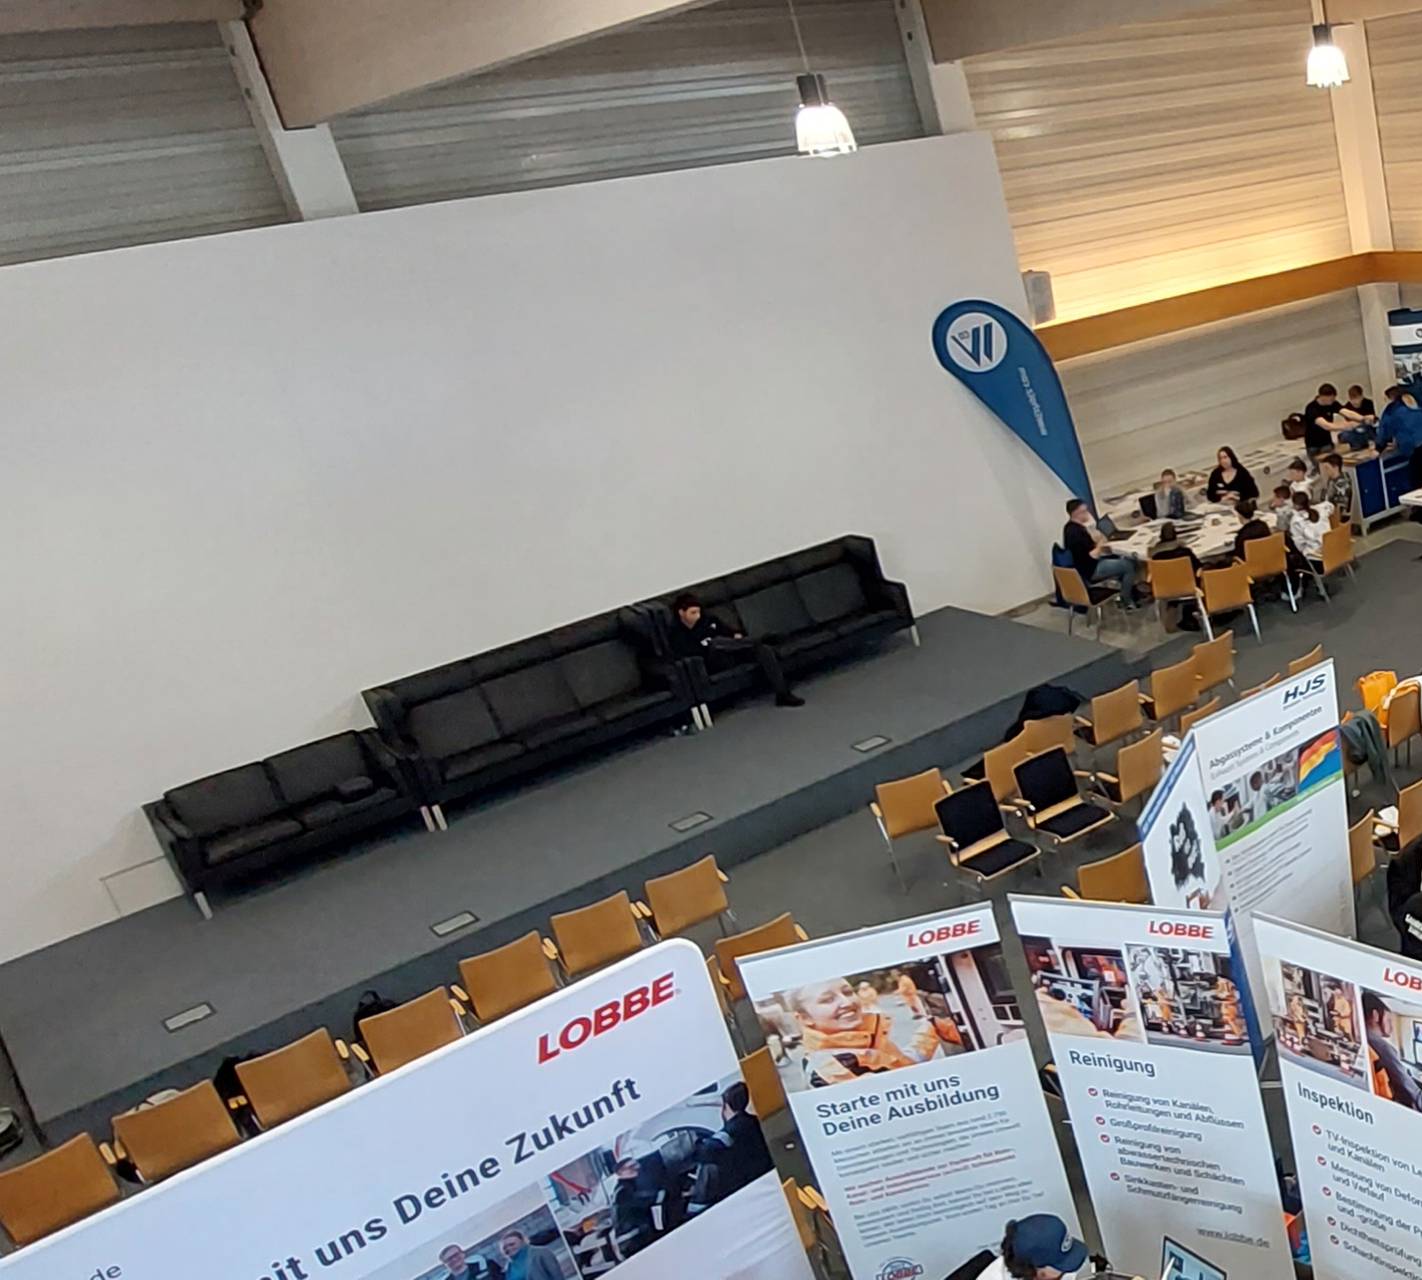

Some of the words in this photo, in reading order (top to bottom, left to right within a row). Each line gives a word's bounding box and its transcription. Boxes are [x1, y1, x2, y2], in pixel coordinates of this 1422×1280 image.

[1283, 673, 1326, 704] HJS
[1209, 736, 1264, 769] Abgassysteme
[1272, 706, 1323, 736] Komponenten
[907, 919, 983, 948] LOBBE
[1148, 920, 1214, 940] LOBBE
[538, 971, 674, 1064] LOBBE
[1069, 1050, 1156, 1078] Reinigung
[816, 1094, 881, 1119] Starte
[885, 1081, 920, 1103] mit
[923, 1073, 961, 1095] uns
[1103, 1089, 1150, 1106] Reinigung
[1105, 1100, 1172, 1119] Rohrleitungen
[1174, 1110, 1192, 1121] und
[1297, 1082, 1374, 1125] Inspektion
[822, 1109, 882, 1137] Deine
[888, 1085, 1001, 1121] Ausbildung
[1114, 1136, 1162, 1153] Reinigung
[1325, 1129, 1391, 1164] TV-Inspektion
[1392, 1158, 1410, 1172] von
[1327, 1142, 1345, 1156] und
[258, 1256, 309, 1280] it
[314, 1217, 388, 1268] uns
[393, 1156, 502, 1225] Deine
[504, 1078, 641, 1165] Zukunft
[1174, 1166, 1192, 1177] und
[1331, 1160, 1374, 1188] Messung
[1375, 1180, 1393, 1195] von
[1332, 1174, 1350, 1188] und
[1181, 1183, 1199, 1195] und
[1335, 1191, 1394, 1226] Bestimmung
[1337, 1203, 1355, 1218] und
